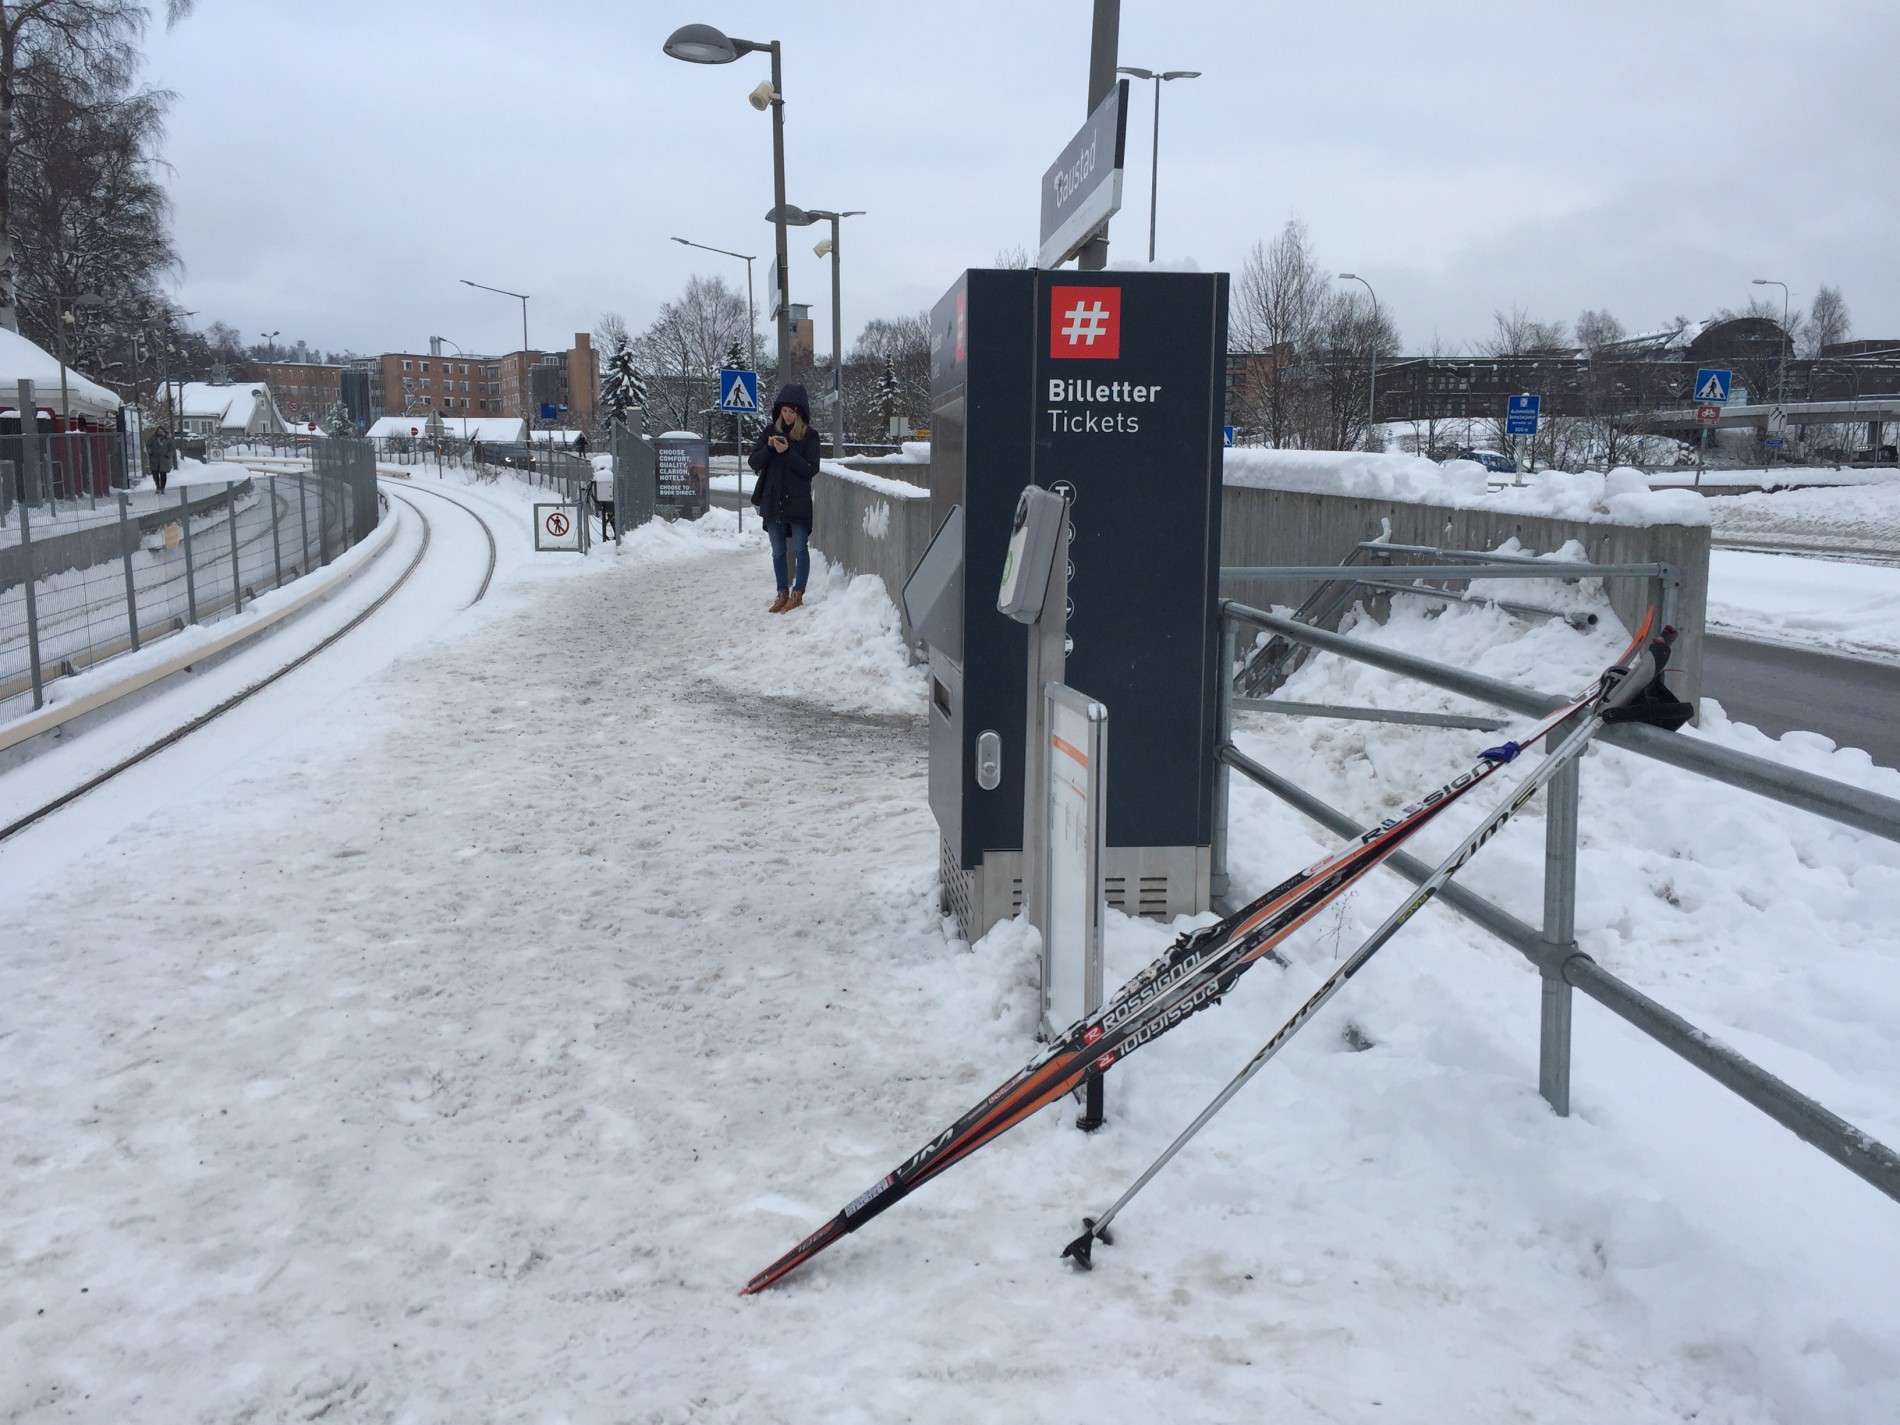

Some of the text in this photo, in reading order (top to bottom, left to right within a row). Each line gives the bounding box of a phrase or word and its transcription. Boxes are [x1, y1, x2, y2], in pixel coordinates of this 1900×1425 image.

[1048, 379, 1162, 402] Billetter
[1047, 409, 1139, 433] Tickets
[659, 455, 692, 463] COMFORT,
[1102, 951, 1204, 1031] ROSSIGNOL
[1117, 980, 1219, 1056] ROSSIGNOL
